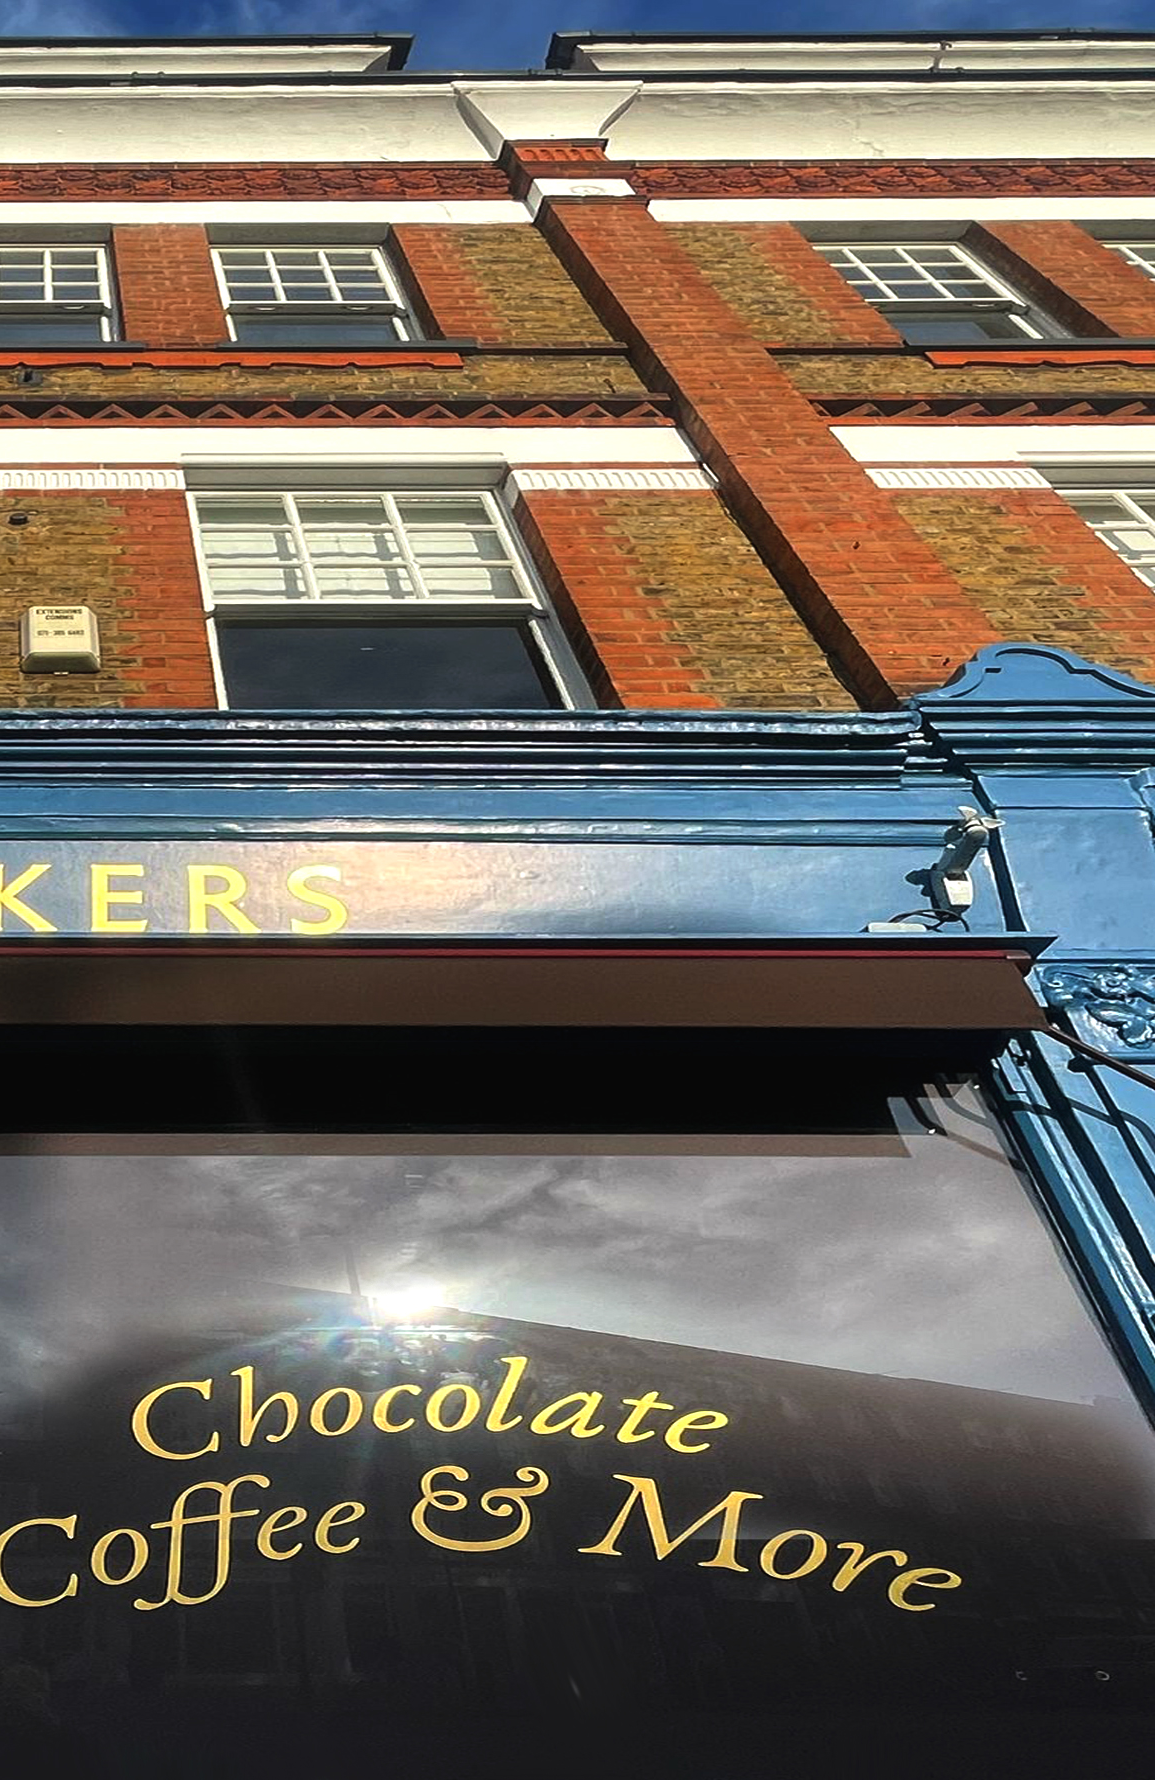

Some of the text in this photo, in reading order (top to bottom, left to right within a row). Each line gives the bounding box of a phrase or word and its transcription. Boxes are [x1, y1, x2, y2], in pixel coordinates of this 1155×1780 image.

[130, 1355, 730, 1461] Chocolate
[410, 1465, 550, 1553] &
[578, 1474, 963, 1612] More
